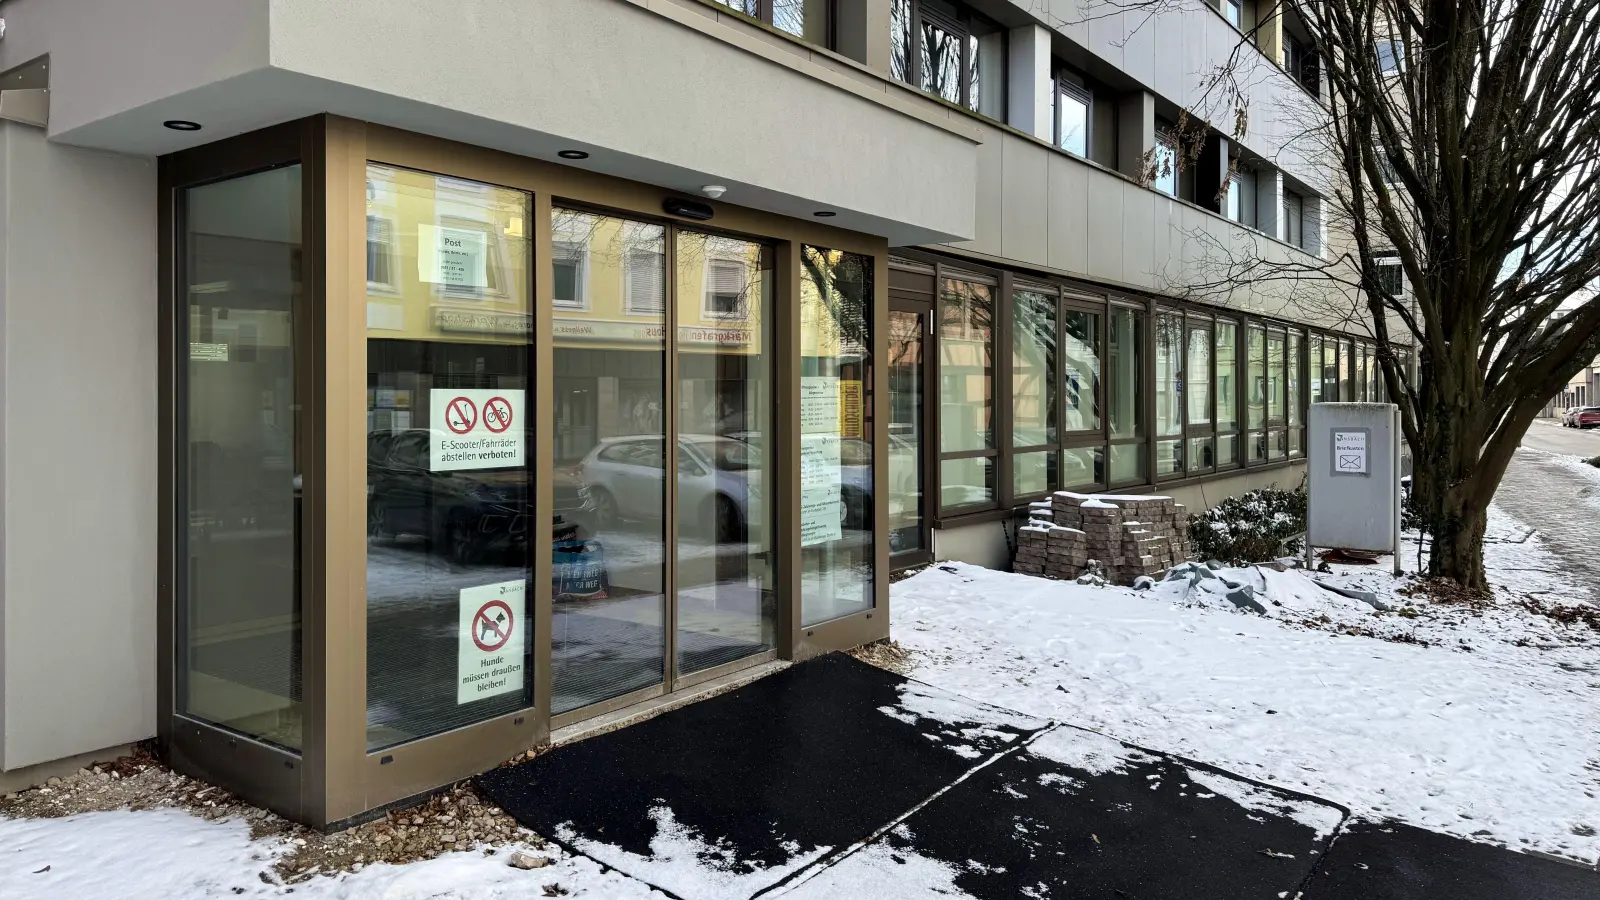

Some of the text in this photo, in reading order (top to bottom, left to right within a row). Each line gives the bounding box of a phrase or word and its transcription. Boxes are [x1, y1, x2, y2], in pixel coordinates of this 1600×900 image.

[444, 237, 462, 248] Post
[441, 438, 517, 450] E-Scooter/Fahrräder
[441, 449, 516, 462] abstellen verboten!
[480, 655, 504, 668] Hunde
[462, 664, 521, 684] müssen draußen
[477, 678, 507, 692] bleiben!
